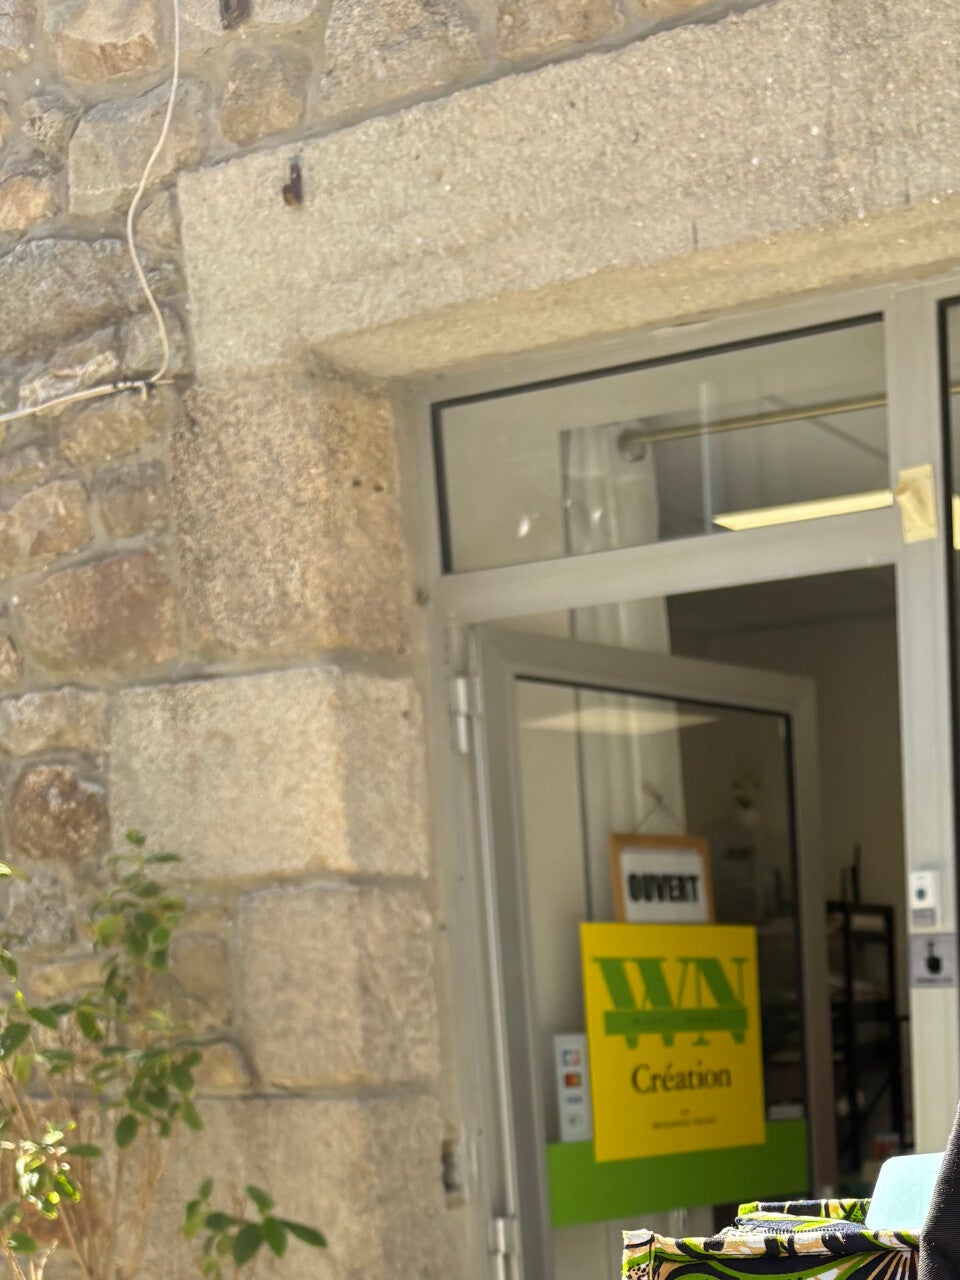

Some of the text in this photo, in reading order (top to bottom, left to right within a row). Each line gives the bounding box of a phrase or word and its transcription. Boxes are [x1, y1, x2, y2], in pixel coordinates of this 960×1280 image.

[628, 873, 699, 902] OUVERT
[592, 956, 749, 1049] WN
[631, 1060, 732, 1094] Création
